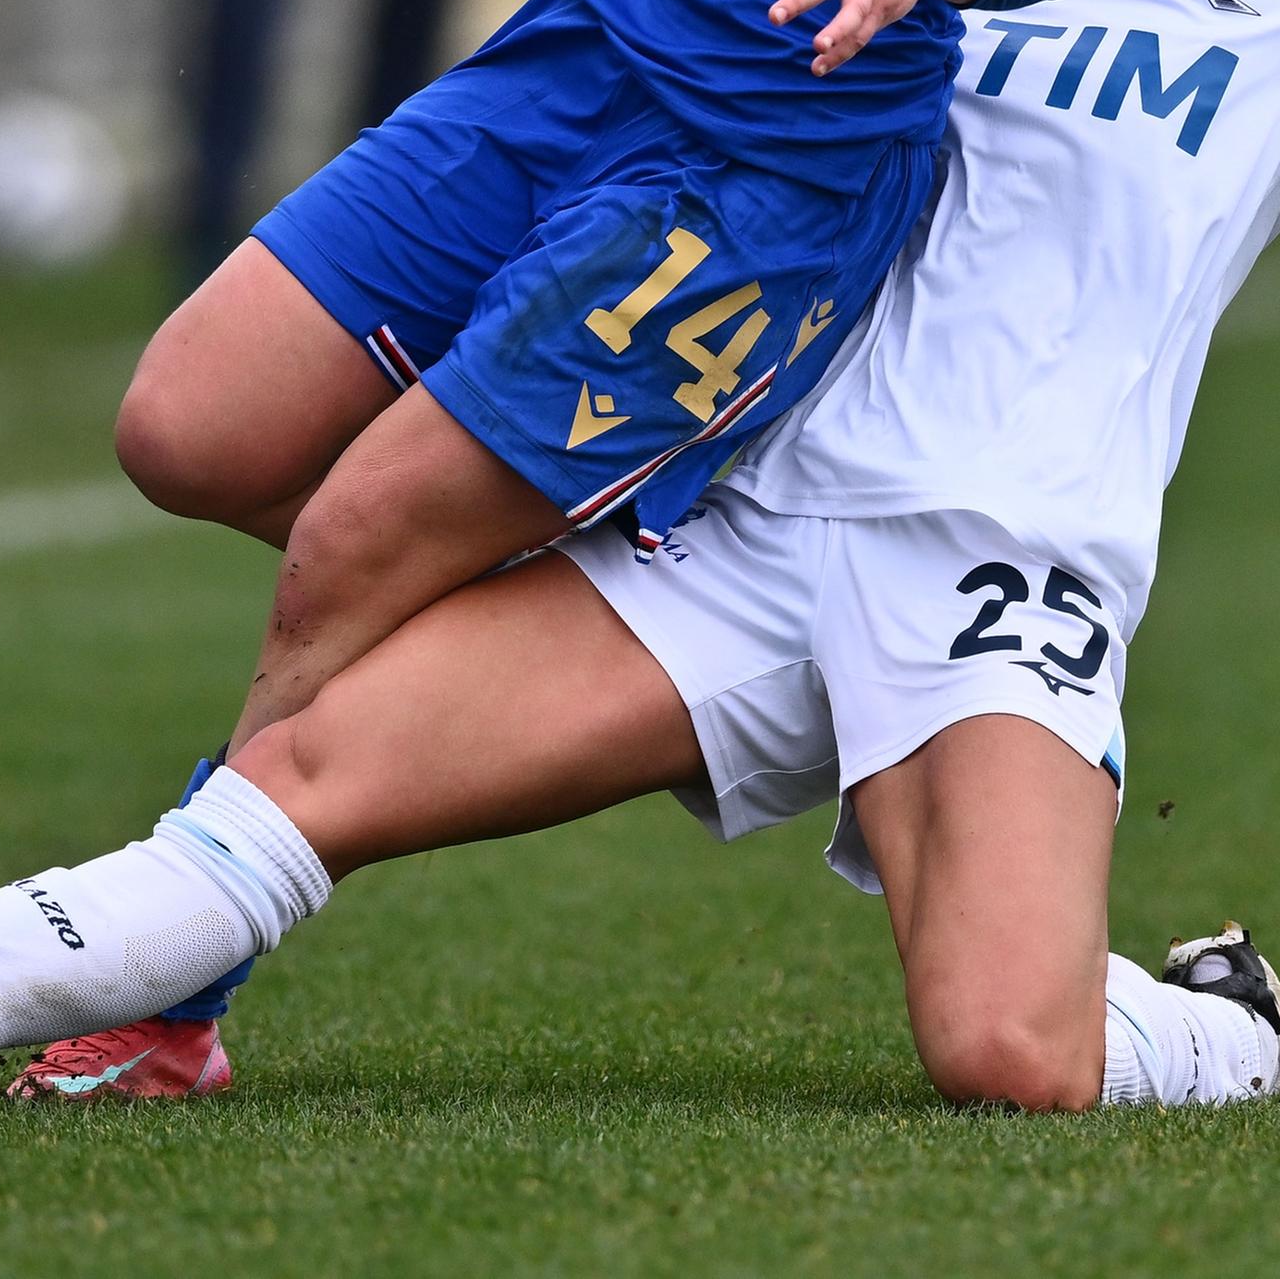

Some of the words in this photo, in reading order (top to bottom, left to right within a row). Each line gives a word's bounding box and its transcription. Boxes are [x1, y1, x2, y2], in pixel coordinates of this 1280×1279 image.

[976, 18, 1239, 157] TIM
[584, 227, 772, 424] 14
[948, 561, 1110, 681] 25
